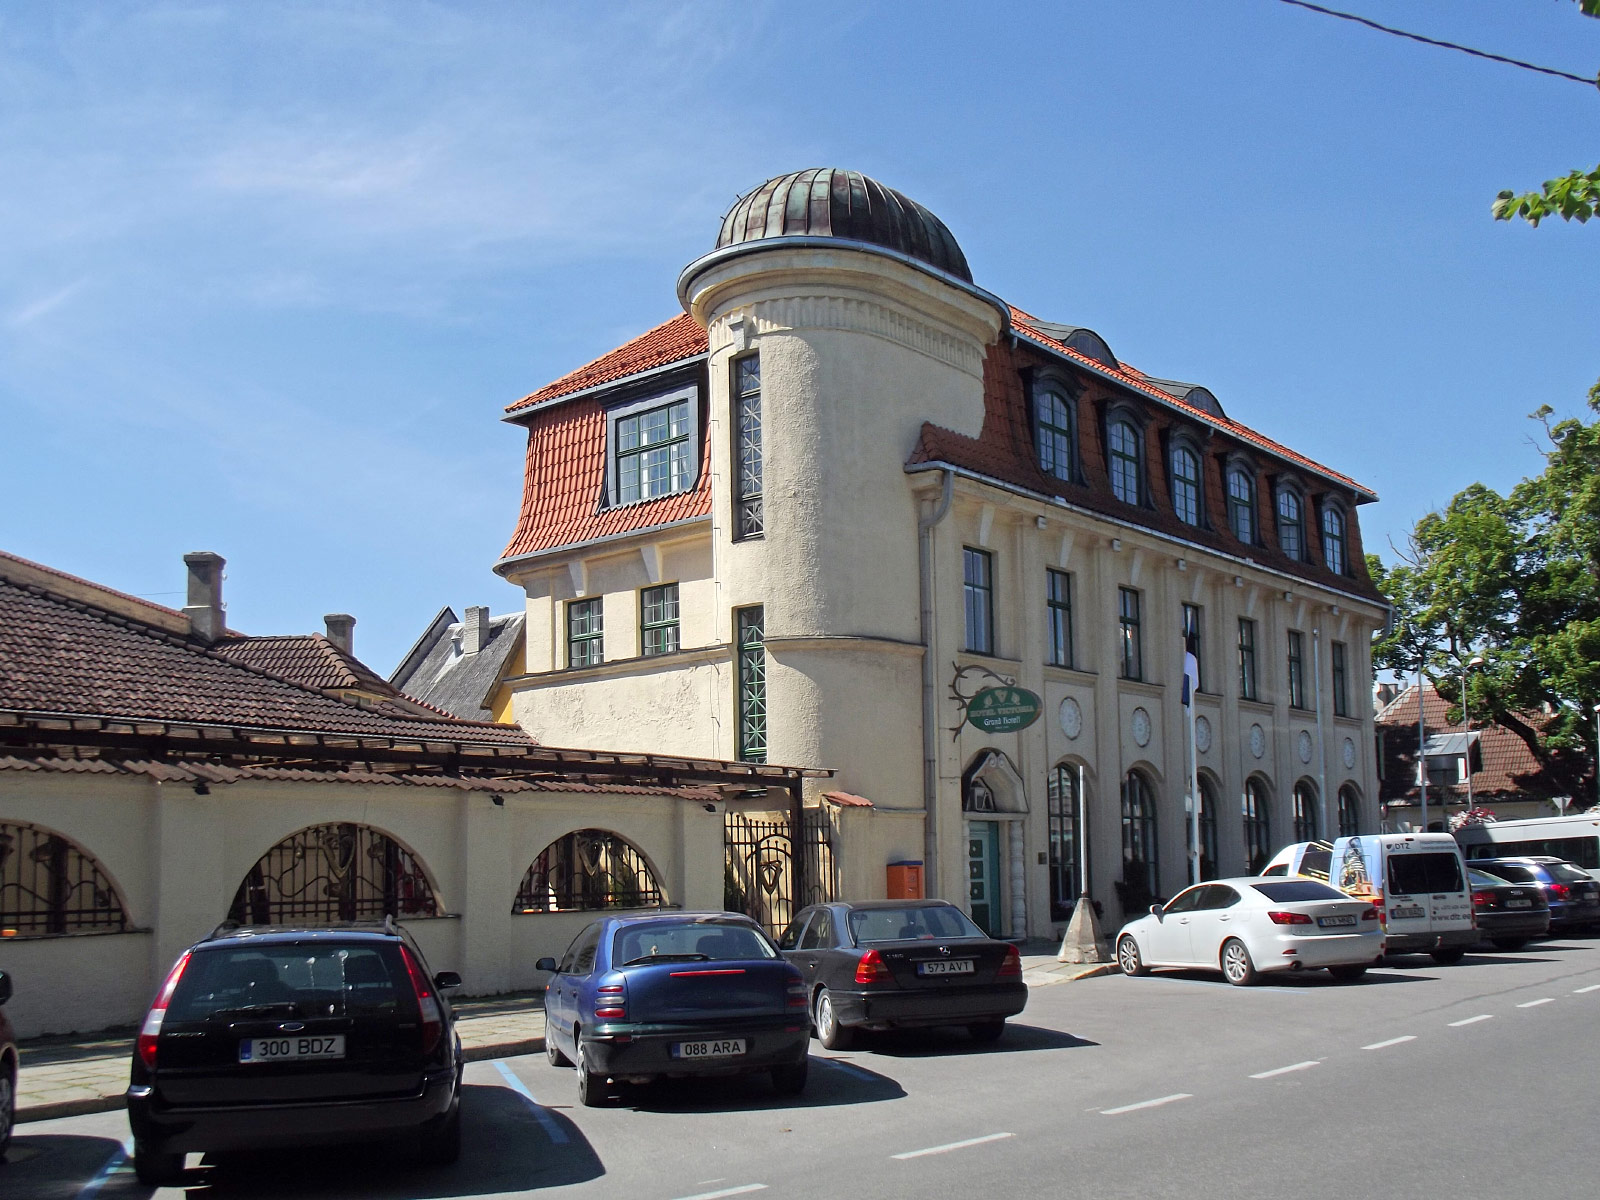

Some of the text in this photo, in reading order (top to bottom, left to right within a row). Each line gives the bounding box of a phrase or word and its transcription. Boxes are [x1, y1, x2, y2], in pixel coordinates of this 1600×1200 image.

[969, 705, 1035, 718] HOTEL VICTORIA
[983, 717, 1002, 726] Grand
[1394, 842, 1411, 850] DTZ
[928, 961, 969, 973] 573 AVT
[259, 1037, 336, 1057] 300 BDZ
[685, 1041, 741, 1056] 088 ARA
